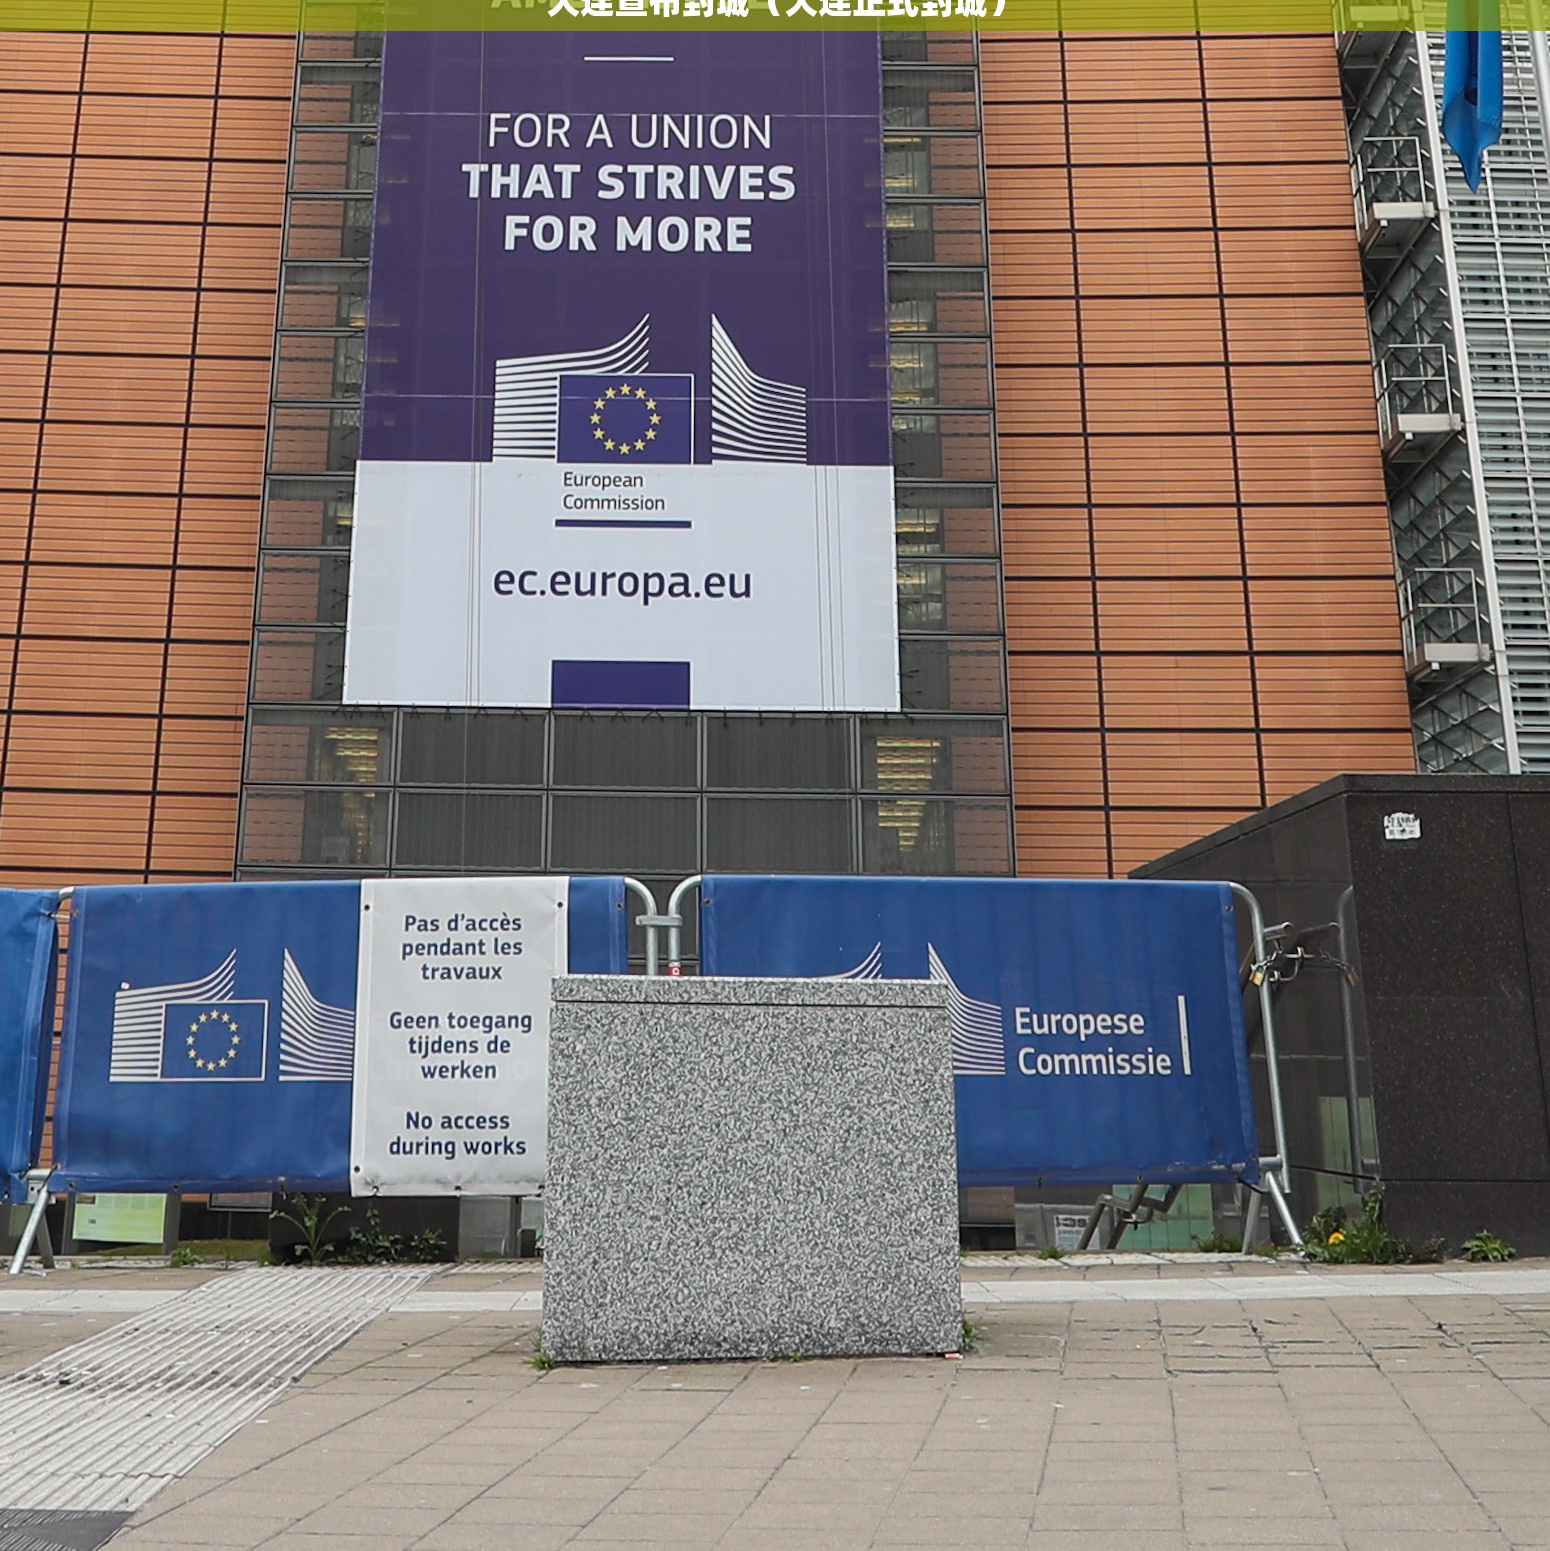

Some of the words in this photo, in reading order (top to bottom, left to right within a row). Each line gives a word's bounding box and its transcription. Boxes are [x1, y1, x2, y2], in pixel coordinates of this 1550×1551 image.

[488, 112, 570, 148] FOR
[585, 113, 614, 148] A
[630, 113, 771, 149] UNION
[461, 163, 581, 199] THAT
[597, 164, 796, 201] STRIVES
[504, 215, 597, 251] FOR
[616, 216, 753, 252] MORE
[563, 471, 644, 491] European
[562, 493, 666, 512] Commission
[493, 569, 752, 607] ec.europa.eu
[404, 914, 440, 933] Pas
[401, 937, 487, 961] pendant
[493, 936, 523, 956] les
[421, 963, 503, 981] travaux
[389, 1011, 440, 1030] Geen
[447, 1011, 532, 1034] toegang
[1014, 1006, 1145, 1042] Europese
[408, 1034, 479, 1060] tijdens
[486, 1034, 511, 1055] de
[420, 1058, 497, 1080] werken
[1017, 1047, 1172, 1076] Commissie
[405, 1111, 433, 1130] No
[440, 1114, 511, 1130] access
[389, 1135, 456, 1161] during
[462, 1135, 527, 1156] works
